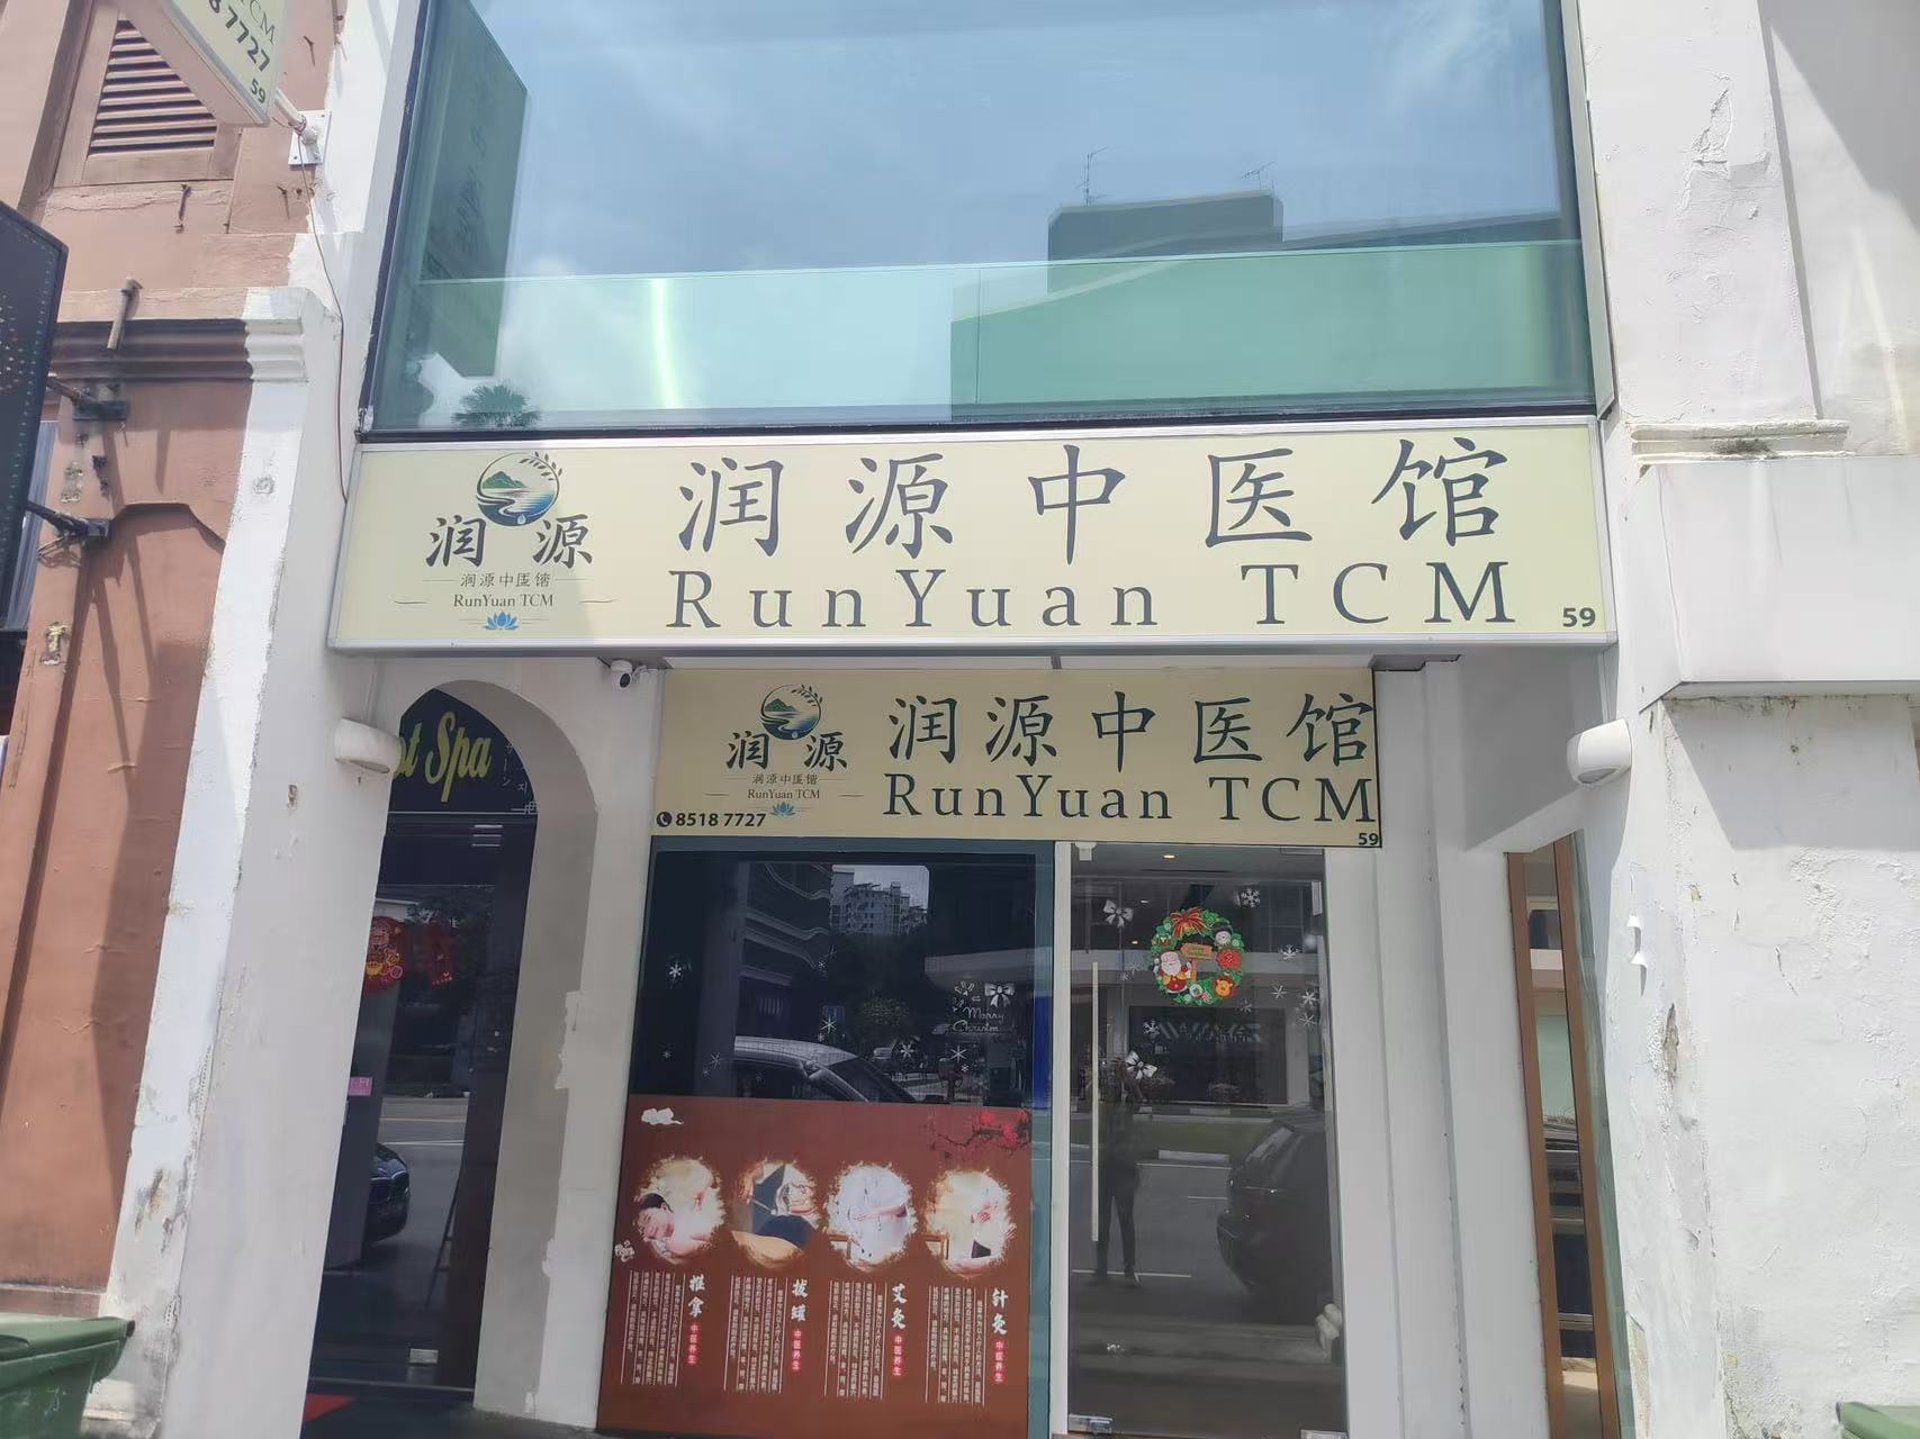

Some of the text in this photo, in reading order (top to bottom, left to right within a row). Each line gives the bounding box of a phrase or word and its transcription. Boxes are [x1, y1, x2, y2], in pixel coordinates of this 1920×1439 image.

[225, 5, 271, 72] 7727
[240, 0, 276, 46] CM
[251, 78, 267, 103] 59
[678, 437, 1508, 566] 润源中医馆
[425, 513, 594, 569] 润源
[453, 594, 554, 608] RunYuan TCM
[667, 561, 1516, 628] RunYuan TCM
[1562, 606, 1597, 629] 59
[725, 730, 848, 771] 润源
[888, 690, 1374, 774] 润源中医馆
[424, 711, 492, 803] Spa
[747, 788, 821, 799] RunYuan TCM
[883, 773, 1376, 823] RunYuan TCM
[675, 812, 767, 828] 8518 7727
[1357, 832, 1379, 847] 59
